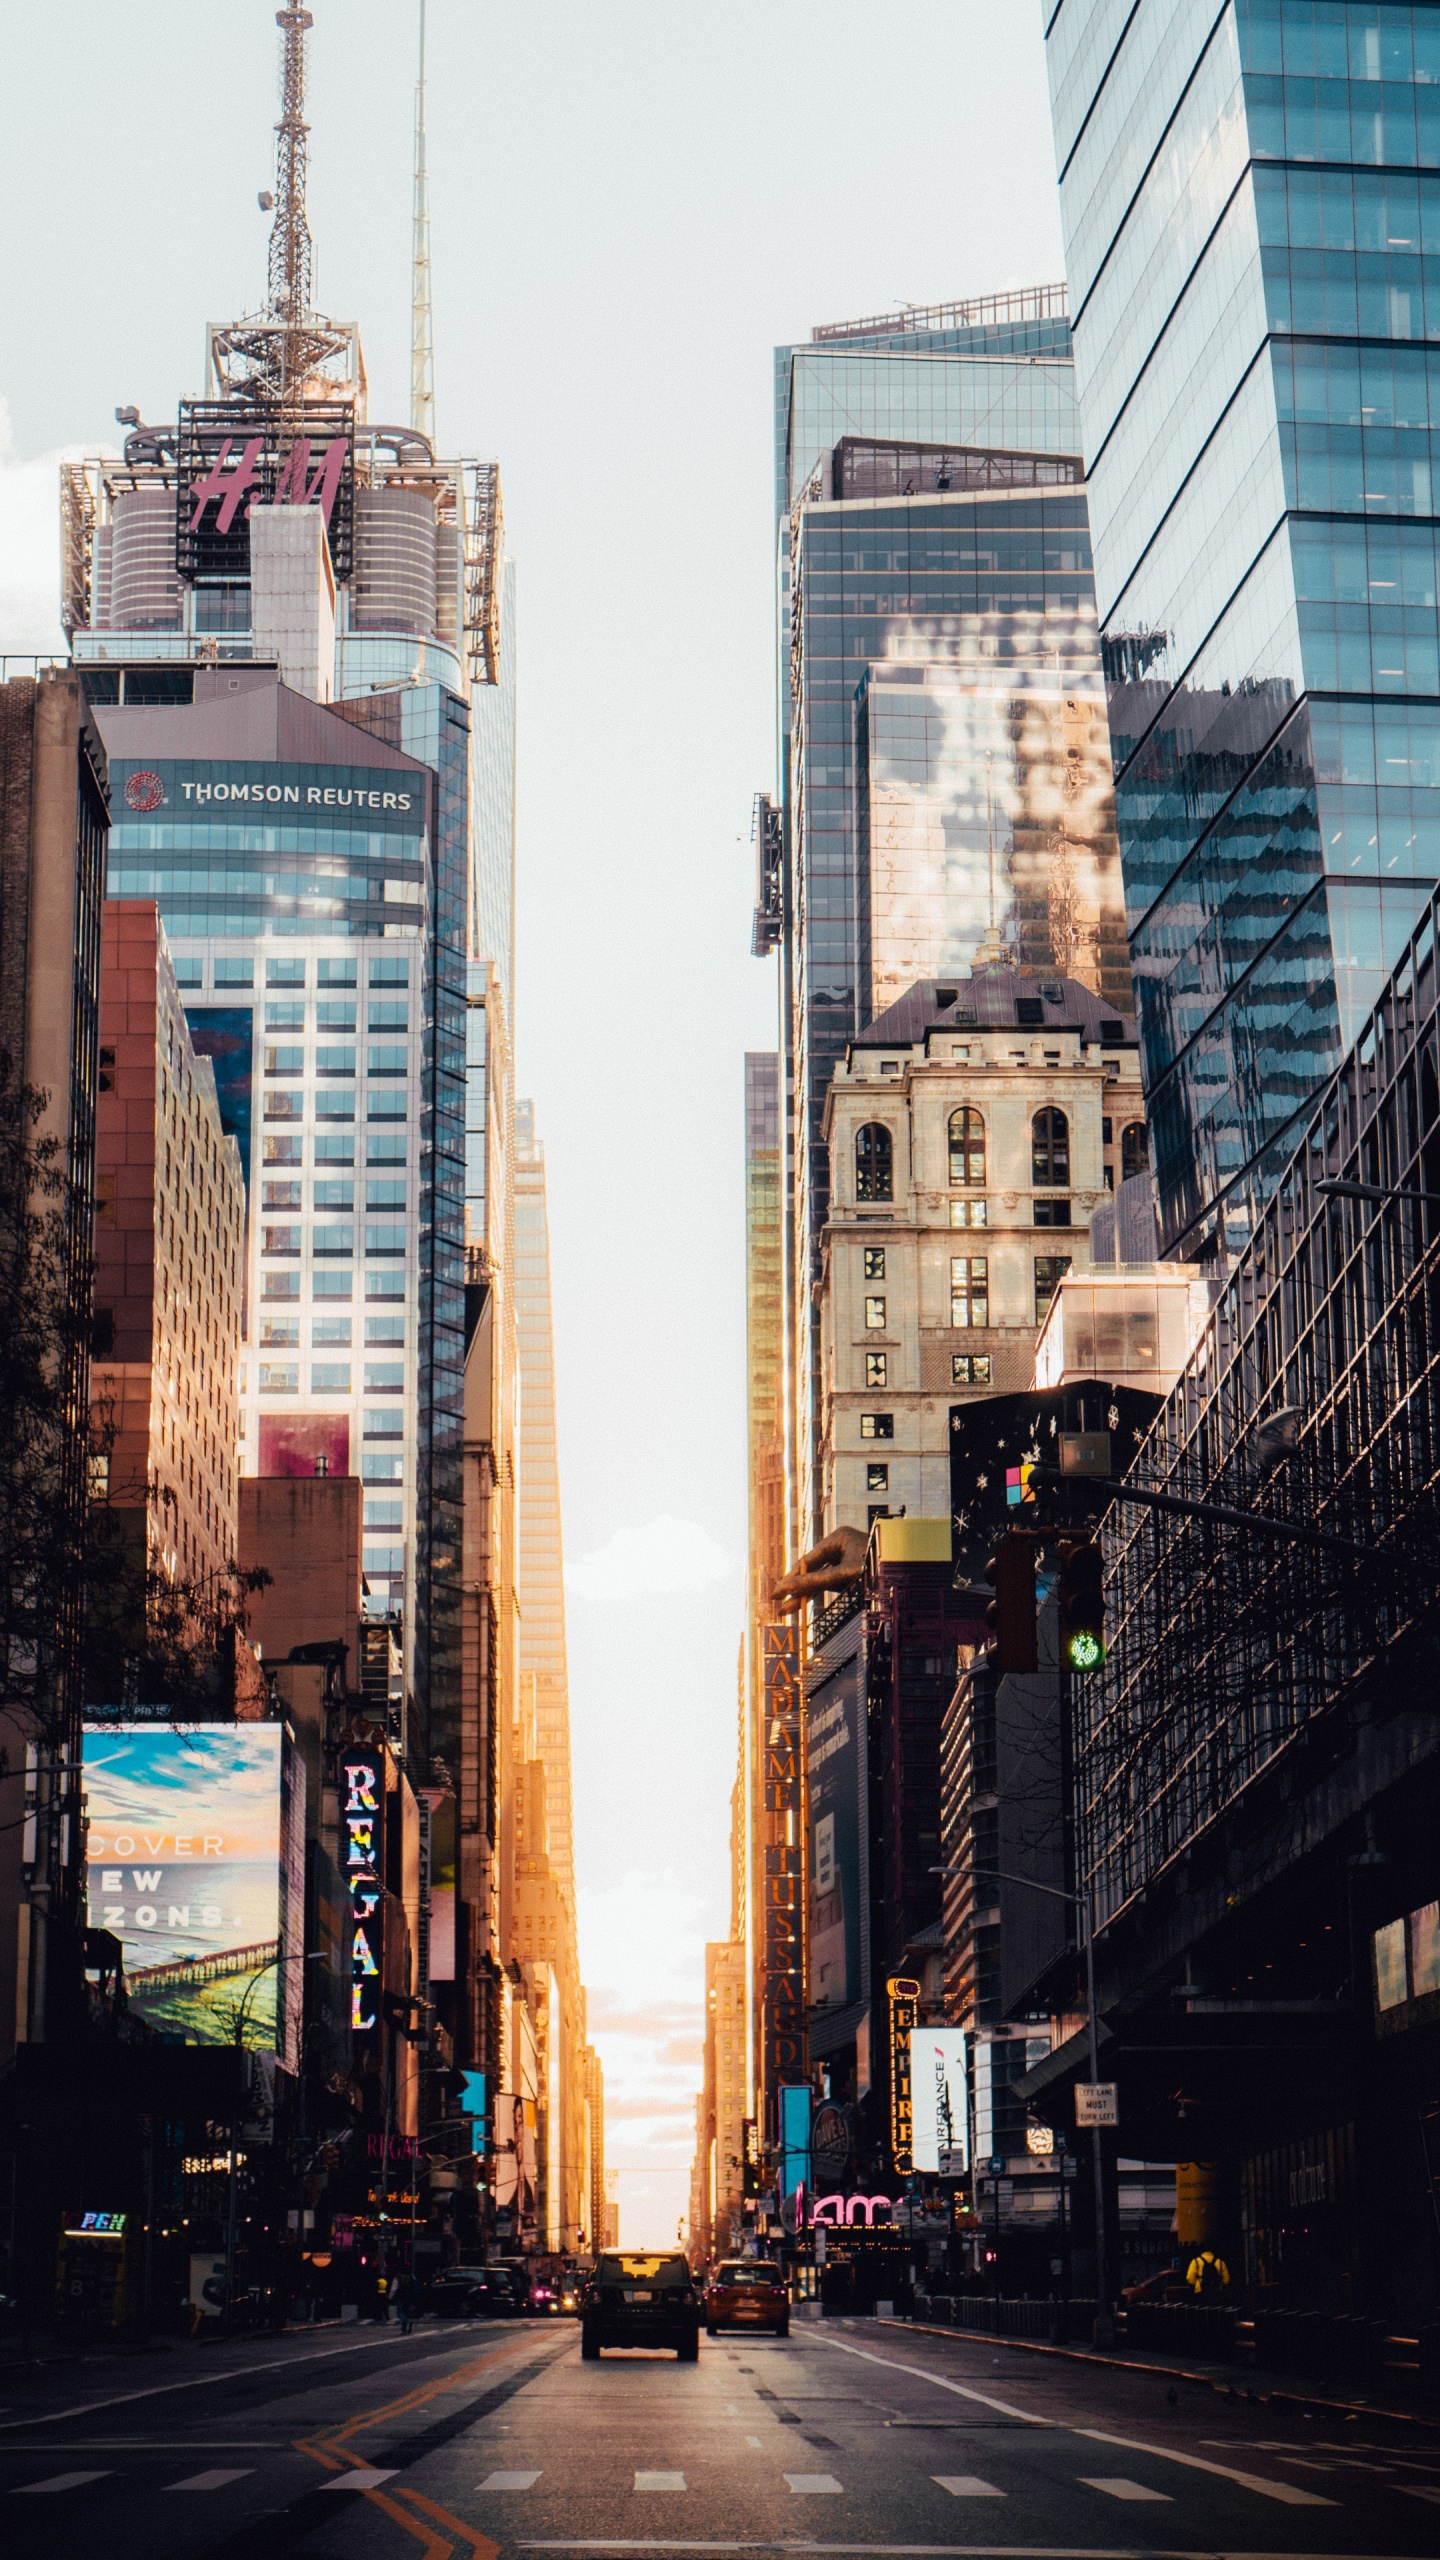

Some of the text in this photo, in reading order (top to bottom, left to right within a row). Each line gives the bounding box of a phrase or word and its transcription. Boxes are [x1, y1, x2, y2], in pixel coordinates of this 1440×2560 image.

[181, 782, 411, 811] THOMSON REUTERS
[87, 1835, 224, 1857] COVER
[767, 1627, 797, 2086] MADAME TUSSAUDS
[344, 1765, 379, 2029] REGAL
[895, 2008, 913, 2142] EMPIRE
[1086, 2100, 1107, 2109] MUST
[1099, 2113, 1115, 2121] LEFT
[65, 2211, 126, 2231] OPEN
